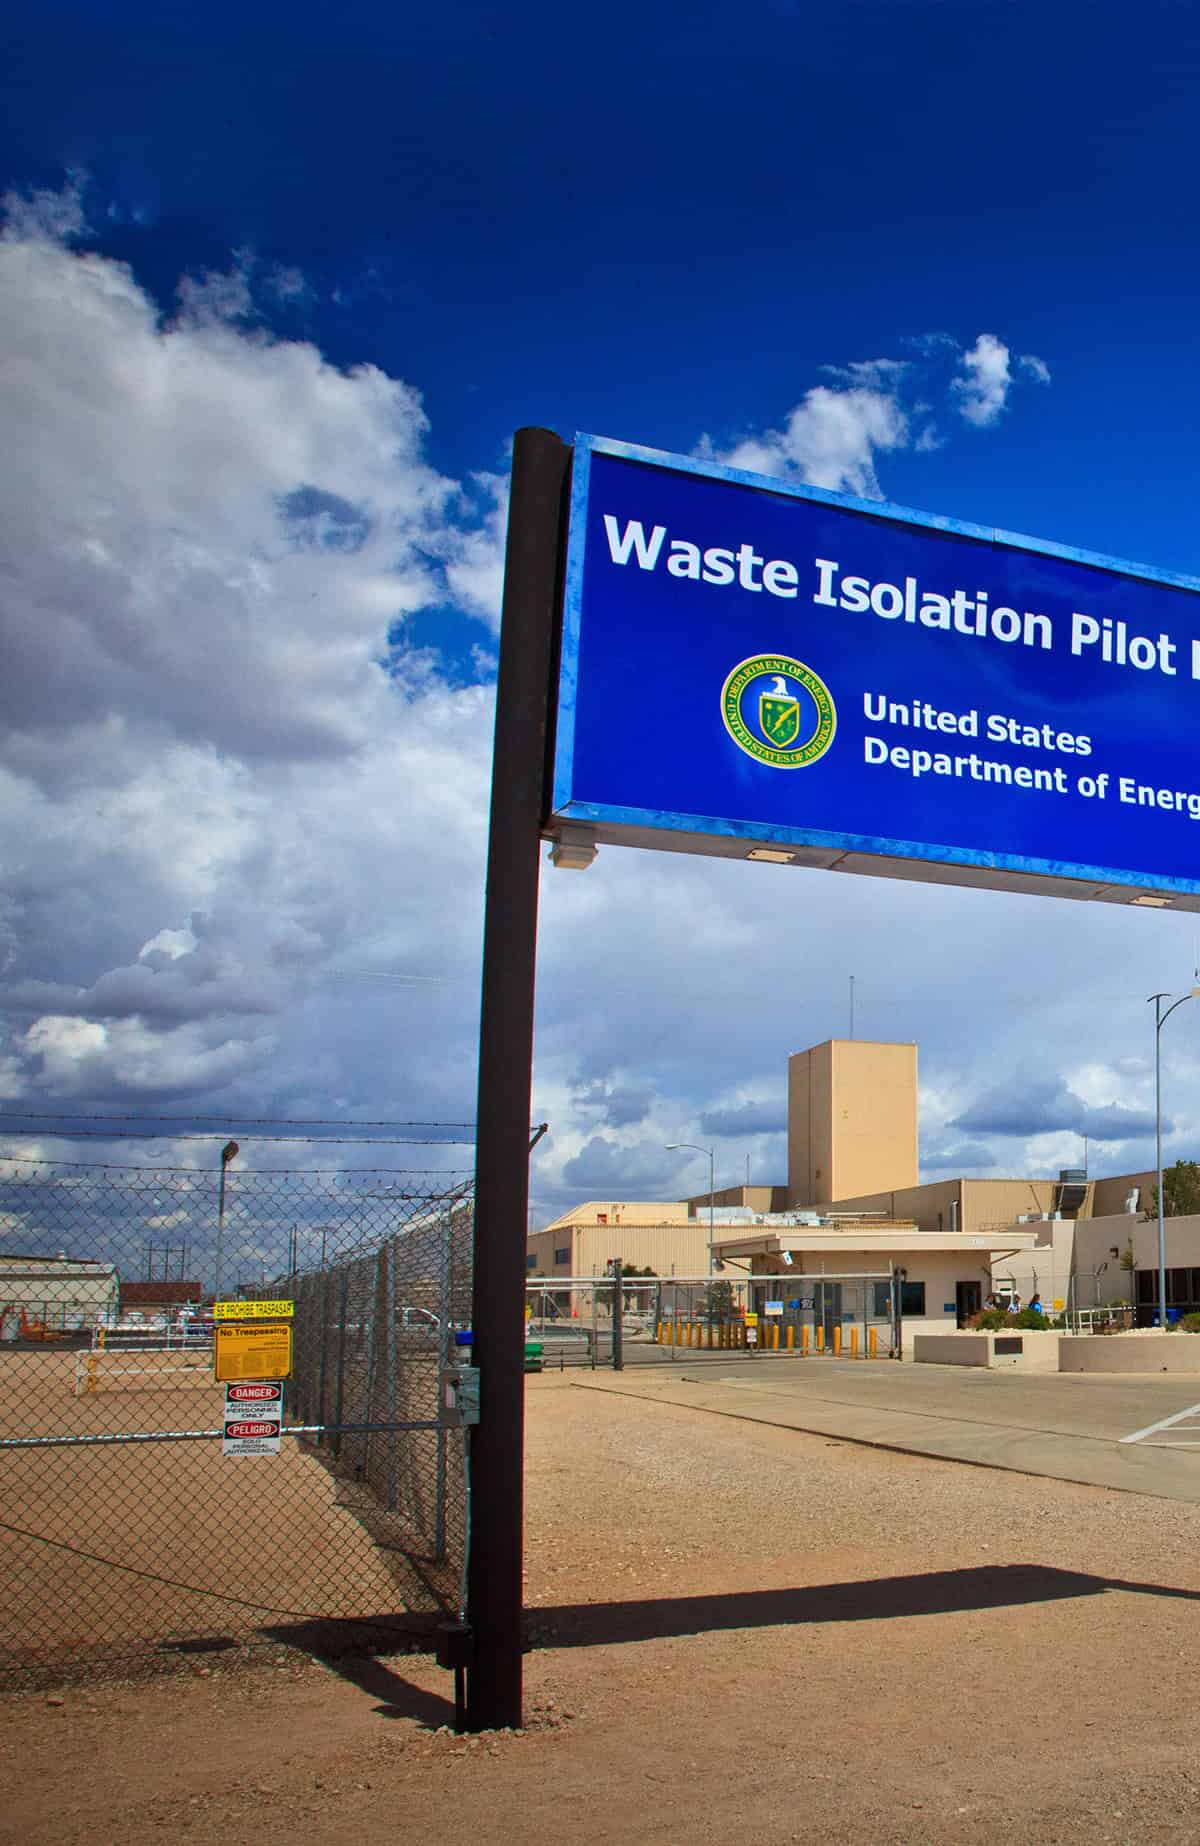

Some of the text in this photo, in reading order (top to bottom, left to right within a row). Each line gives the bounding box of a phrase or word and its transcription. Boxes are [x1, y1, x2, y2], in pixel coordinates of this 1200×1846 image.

[603, 514, 798, 598] Waste
[813, 558, 1052, 649] Isolation
[1071, 612, 1177, 675] Pilot
[728, 660, 830, 714] DEPARTMENT OF ENERGY
[727, 704, 831, 762] UNITED STATES OF AMERICA
[863, 692, 1092, 756] United States
[864, 736, 1068, 793] Department
[1077, 773, 1109, 799] of
[219, 1328, 233, 1337] No
[235, 1327, 288, 1337] Trespassing
[235, 1388, 273, 1398] DANGER
[233, 1424, 272, 1435] PELIGRO
